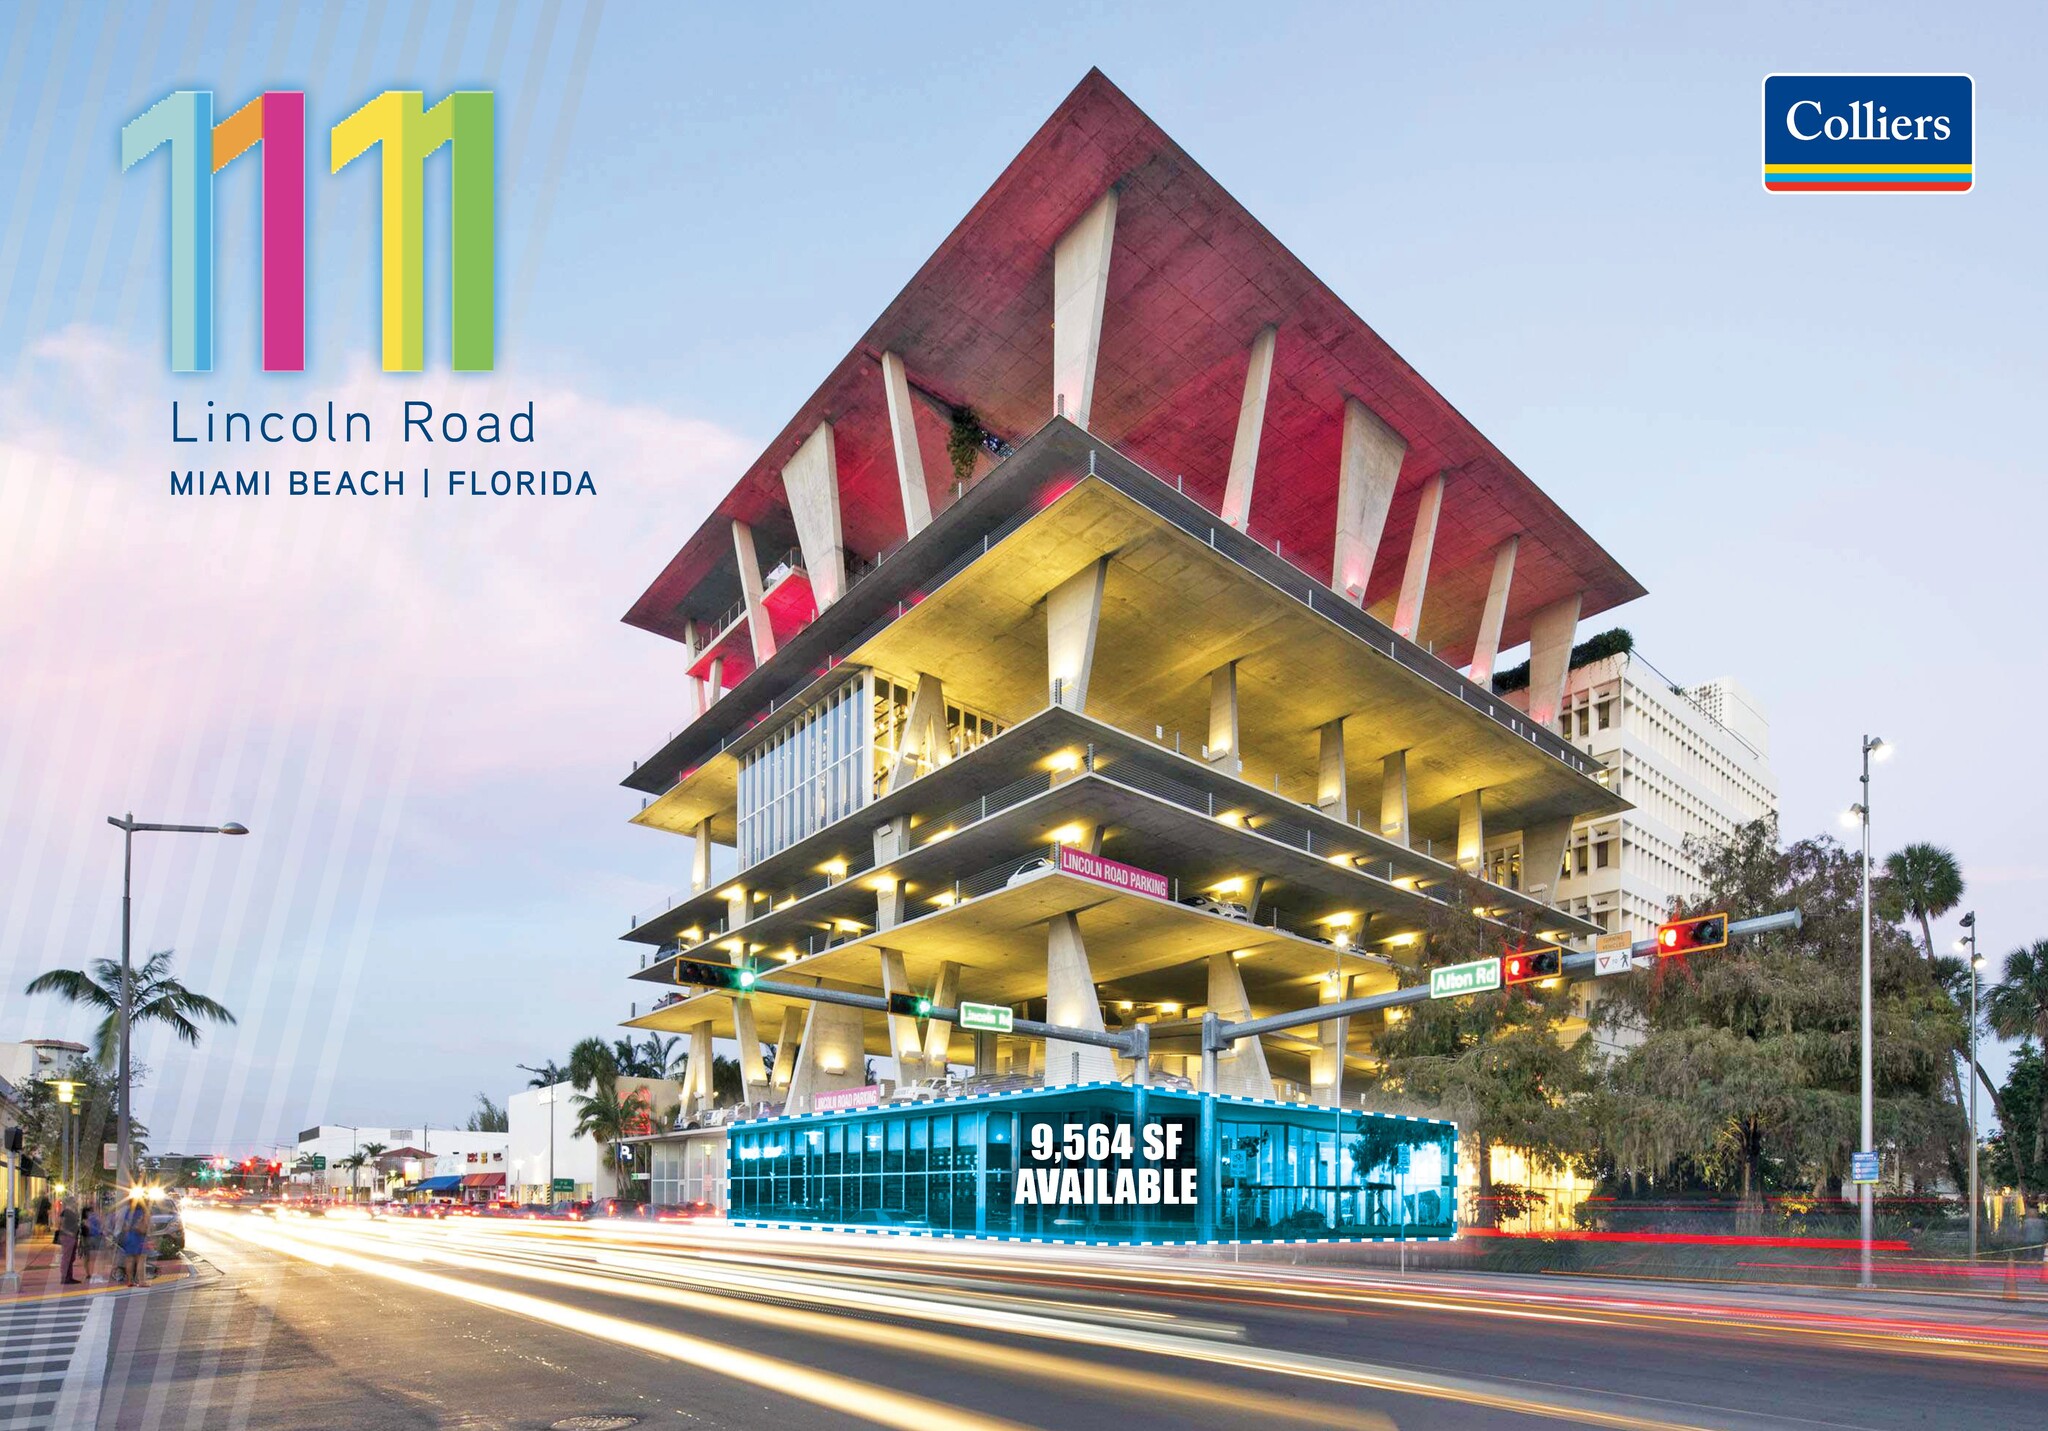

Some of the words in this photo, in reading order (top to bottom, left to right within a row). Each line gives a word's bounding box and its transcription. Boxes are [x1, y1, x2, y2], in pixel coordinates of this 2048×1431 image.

[1063, 852, 1102, 878] LINCOLN
[1104, 865, 1128, 885] ROAD
[1130, 872, 1166, 896] PARKING
[1436, 972, 1473, 992] Alton
[1476, 965, 1496, 985] Rd
